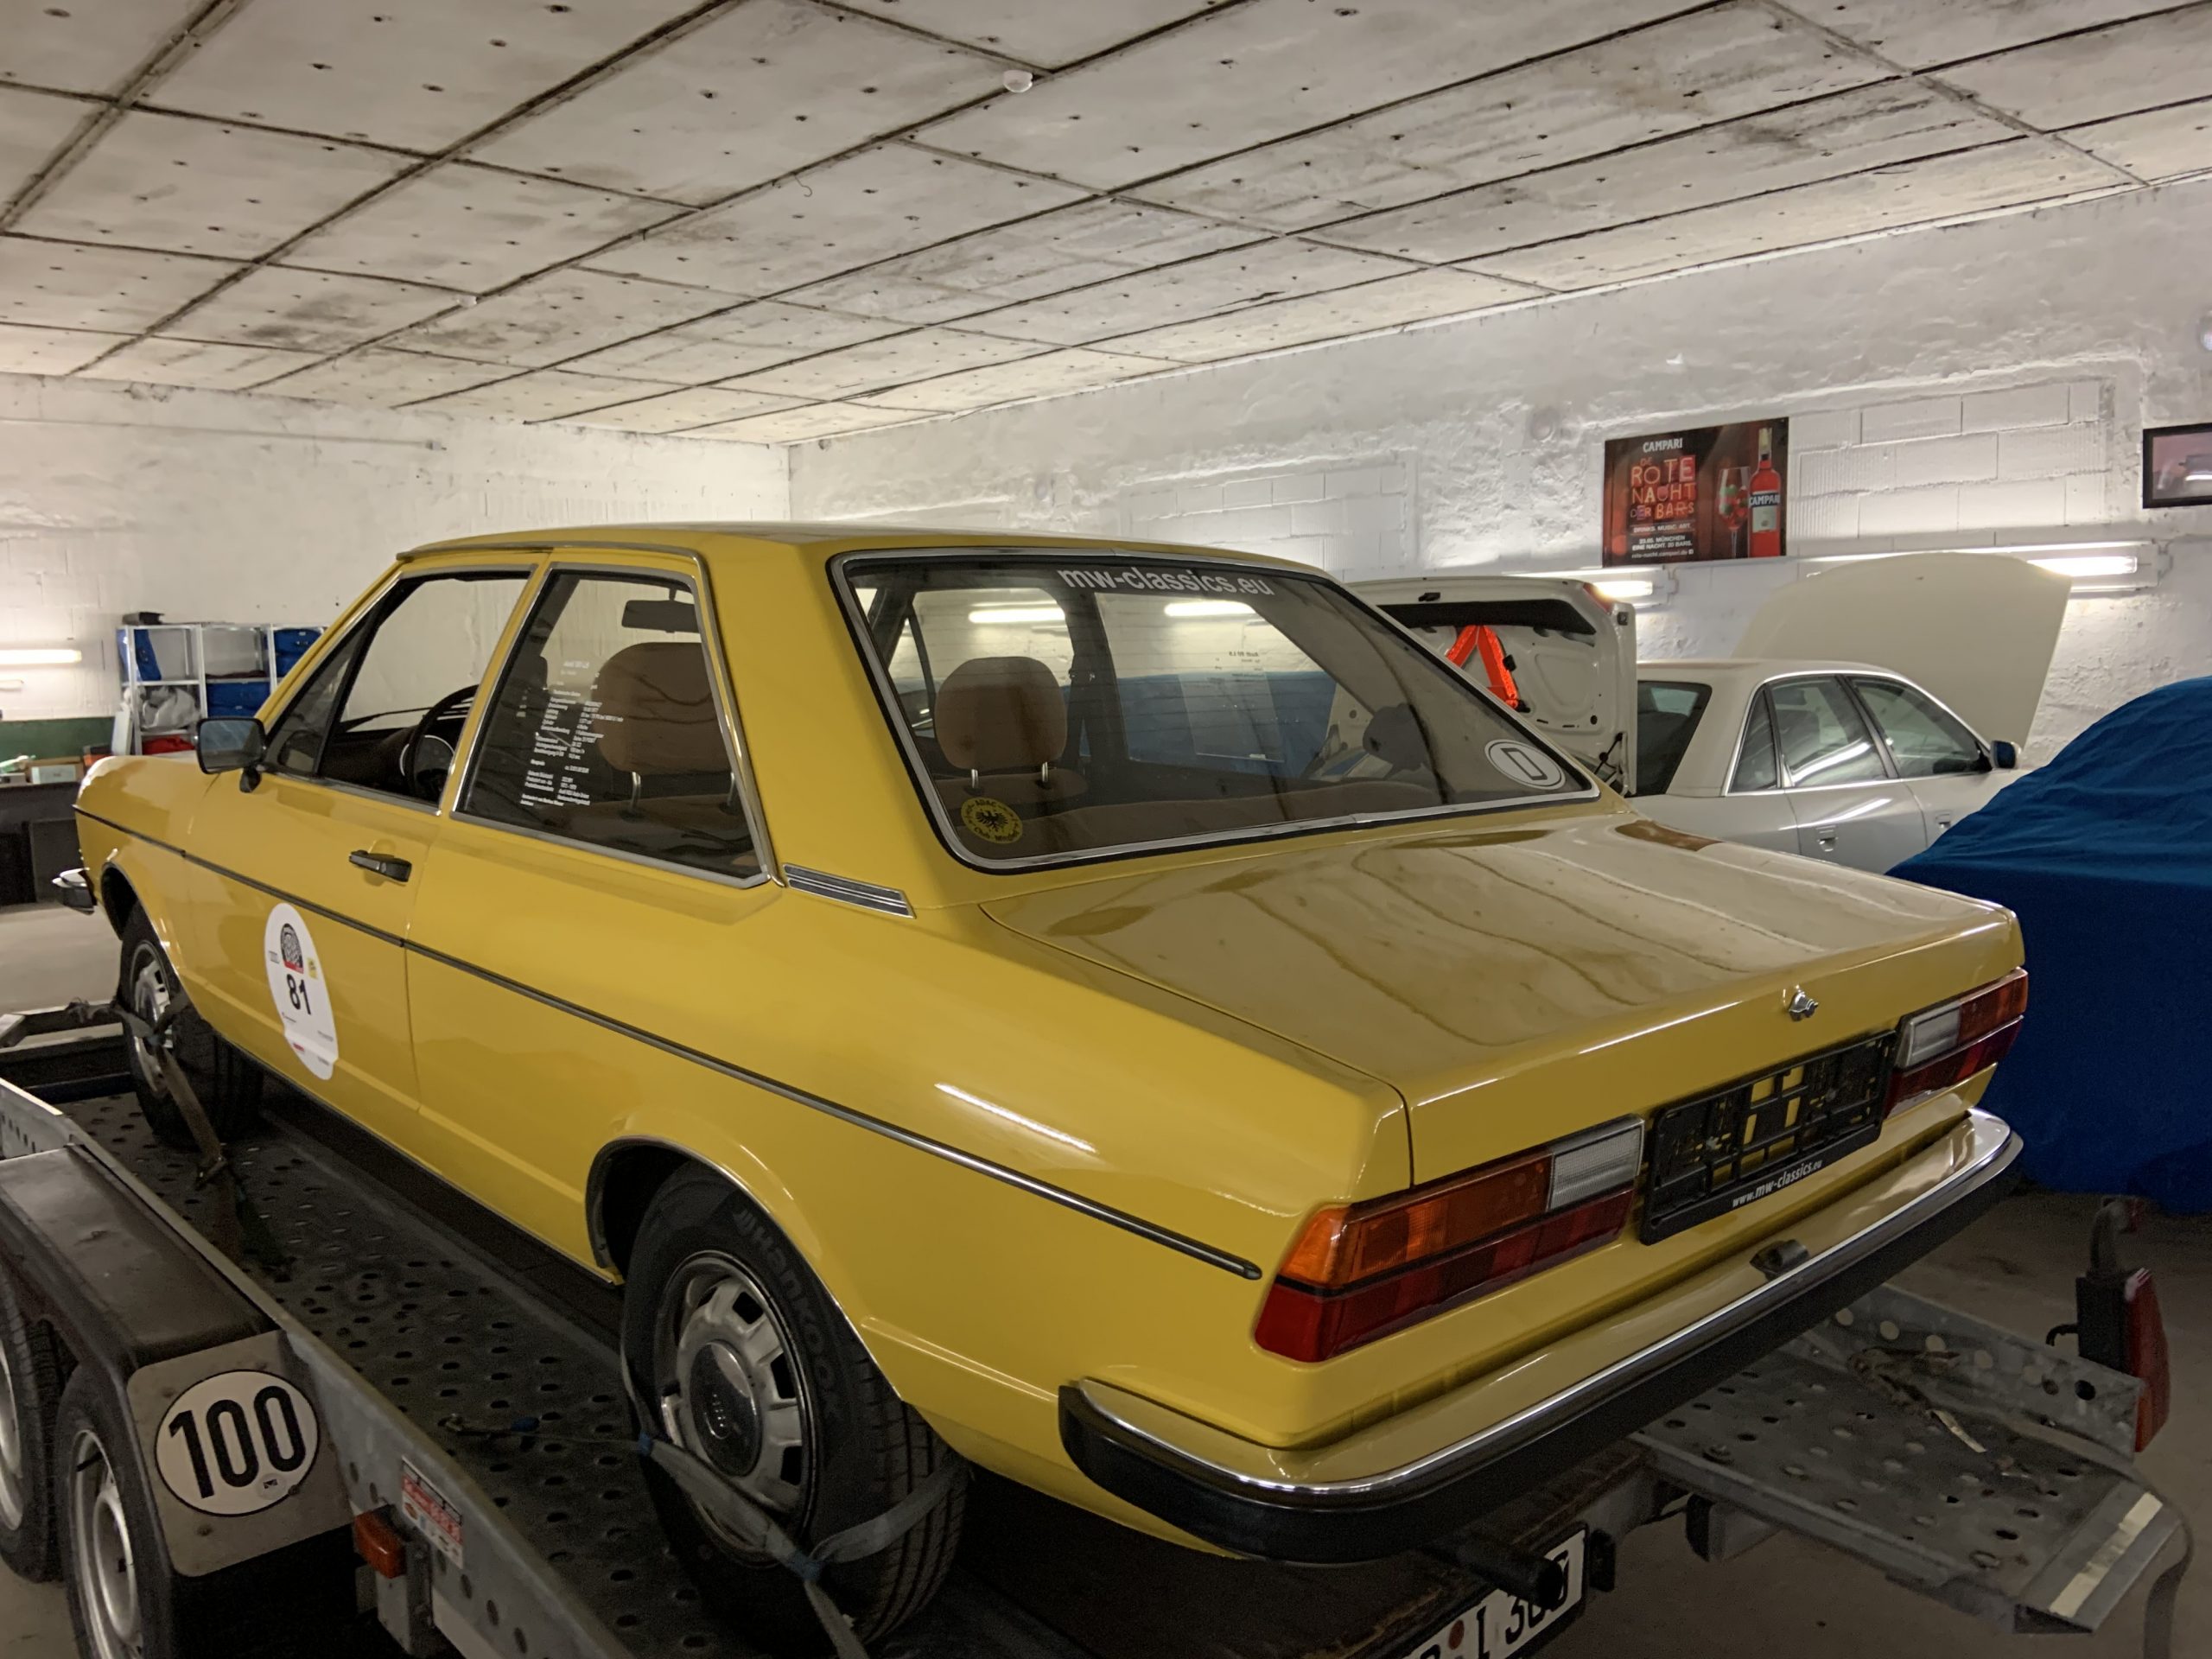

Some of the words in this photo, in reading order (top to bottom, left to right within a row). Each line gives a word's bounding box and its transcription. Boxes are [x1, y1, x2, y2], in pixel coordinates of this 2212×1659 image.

[1643, 438, 1683, 453] CAMPARI
[1630, 456, 1694, 486] ROTE
[1631, 482, 1696, 504] NACHT
[1630, 505, 1652, 519] DER
[1656, 501, 1694, 519] BARS
[1057, 567, 1274, 596] mw-classics.eu
[1500, 747, 1548, 781] D
[286, 973, 312, 1016] 81
[1732, 1160, 1823, 1208] www.mw-classics.eu
[168, 1385, 307, 1499] 100
